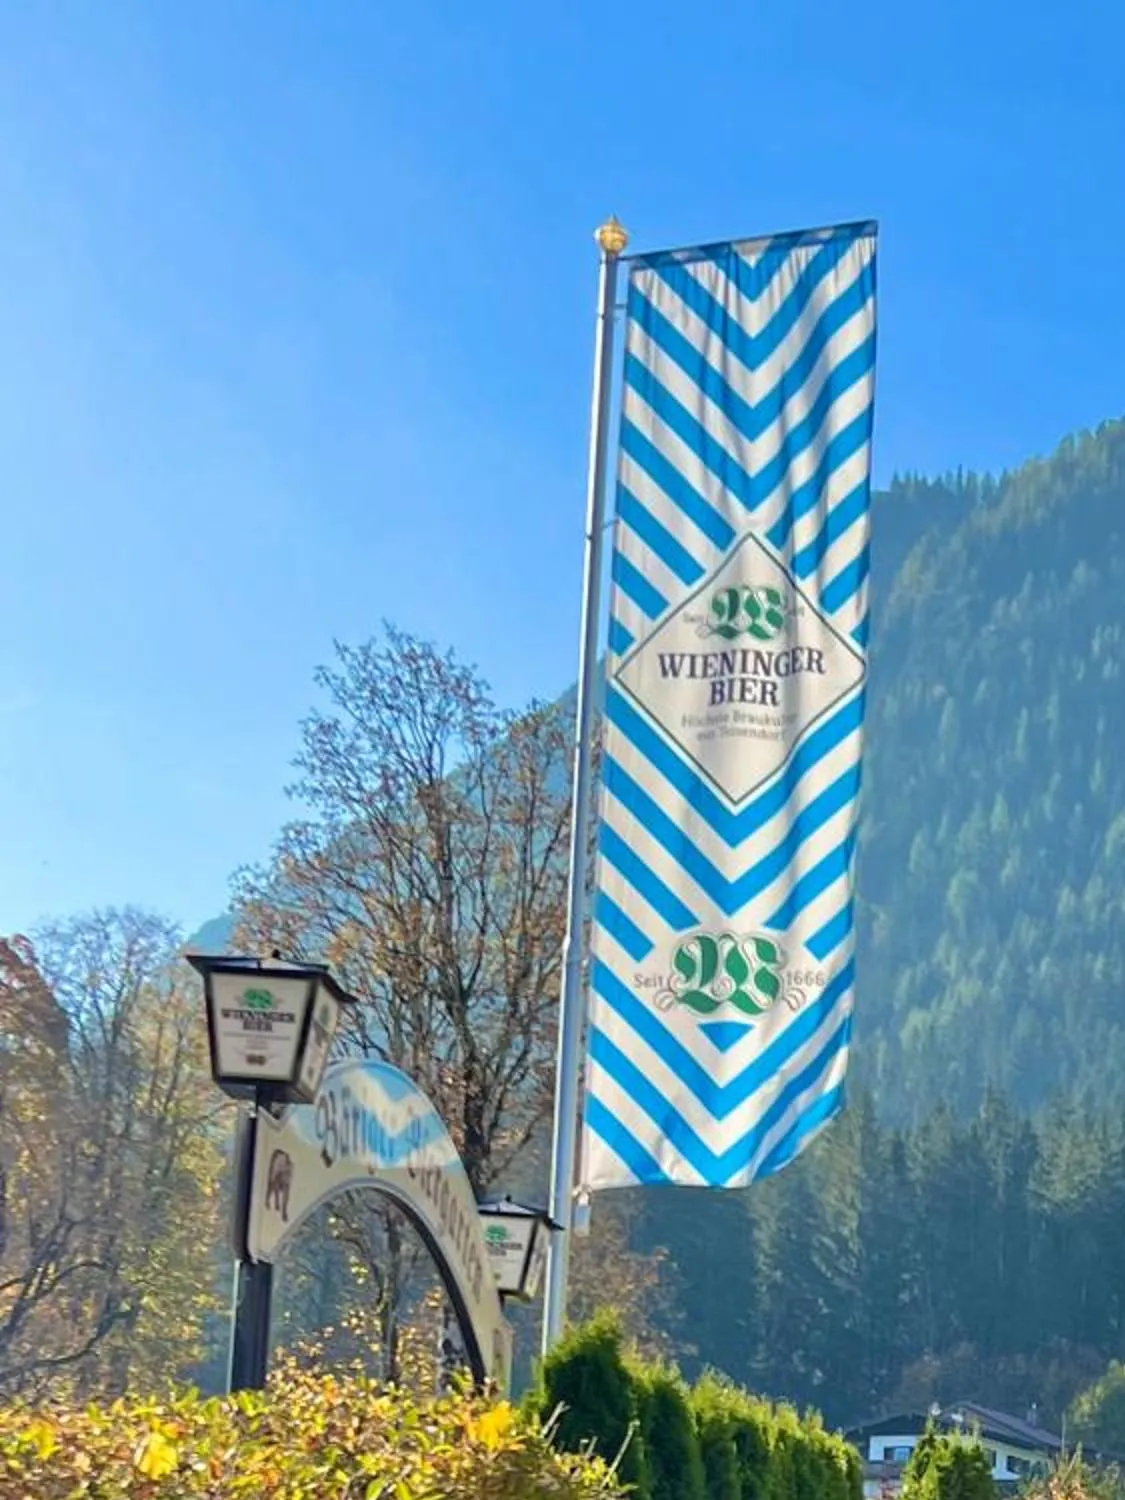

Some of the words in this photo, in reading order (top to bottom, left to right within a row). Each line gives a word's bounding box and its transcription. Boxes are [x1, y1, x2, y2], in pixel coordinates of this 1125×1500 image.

[658, 647, 826, 679] WIENINGER
[709, 677, 780, 707] BIER
[633, 973, 664, 988] Seit
[786, 971, 825, 987] 1666
